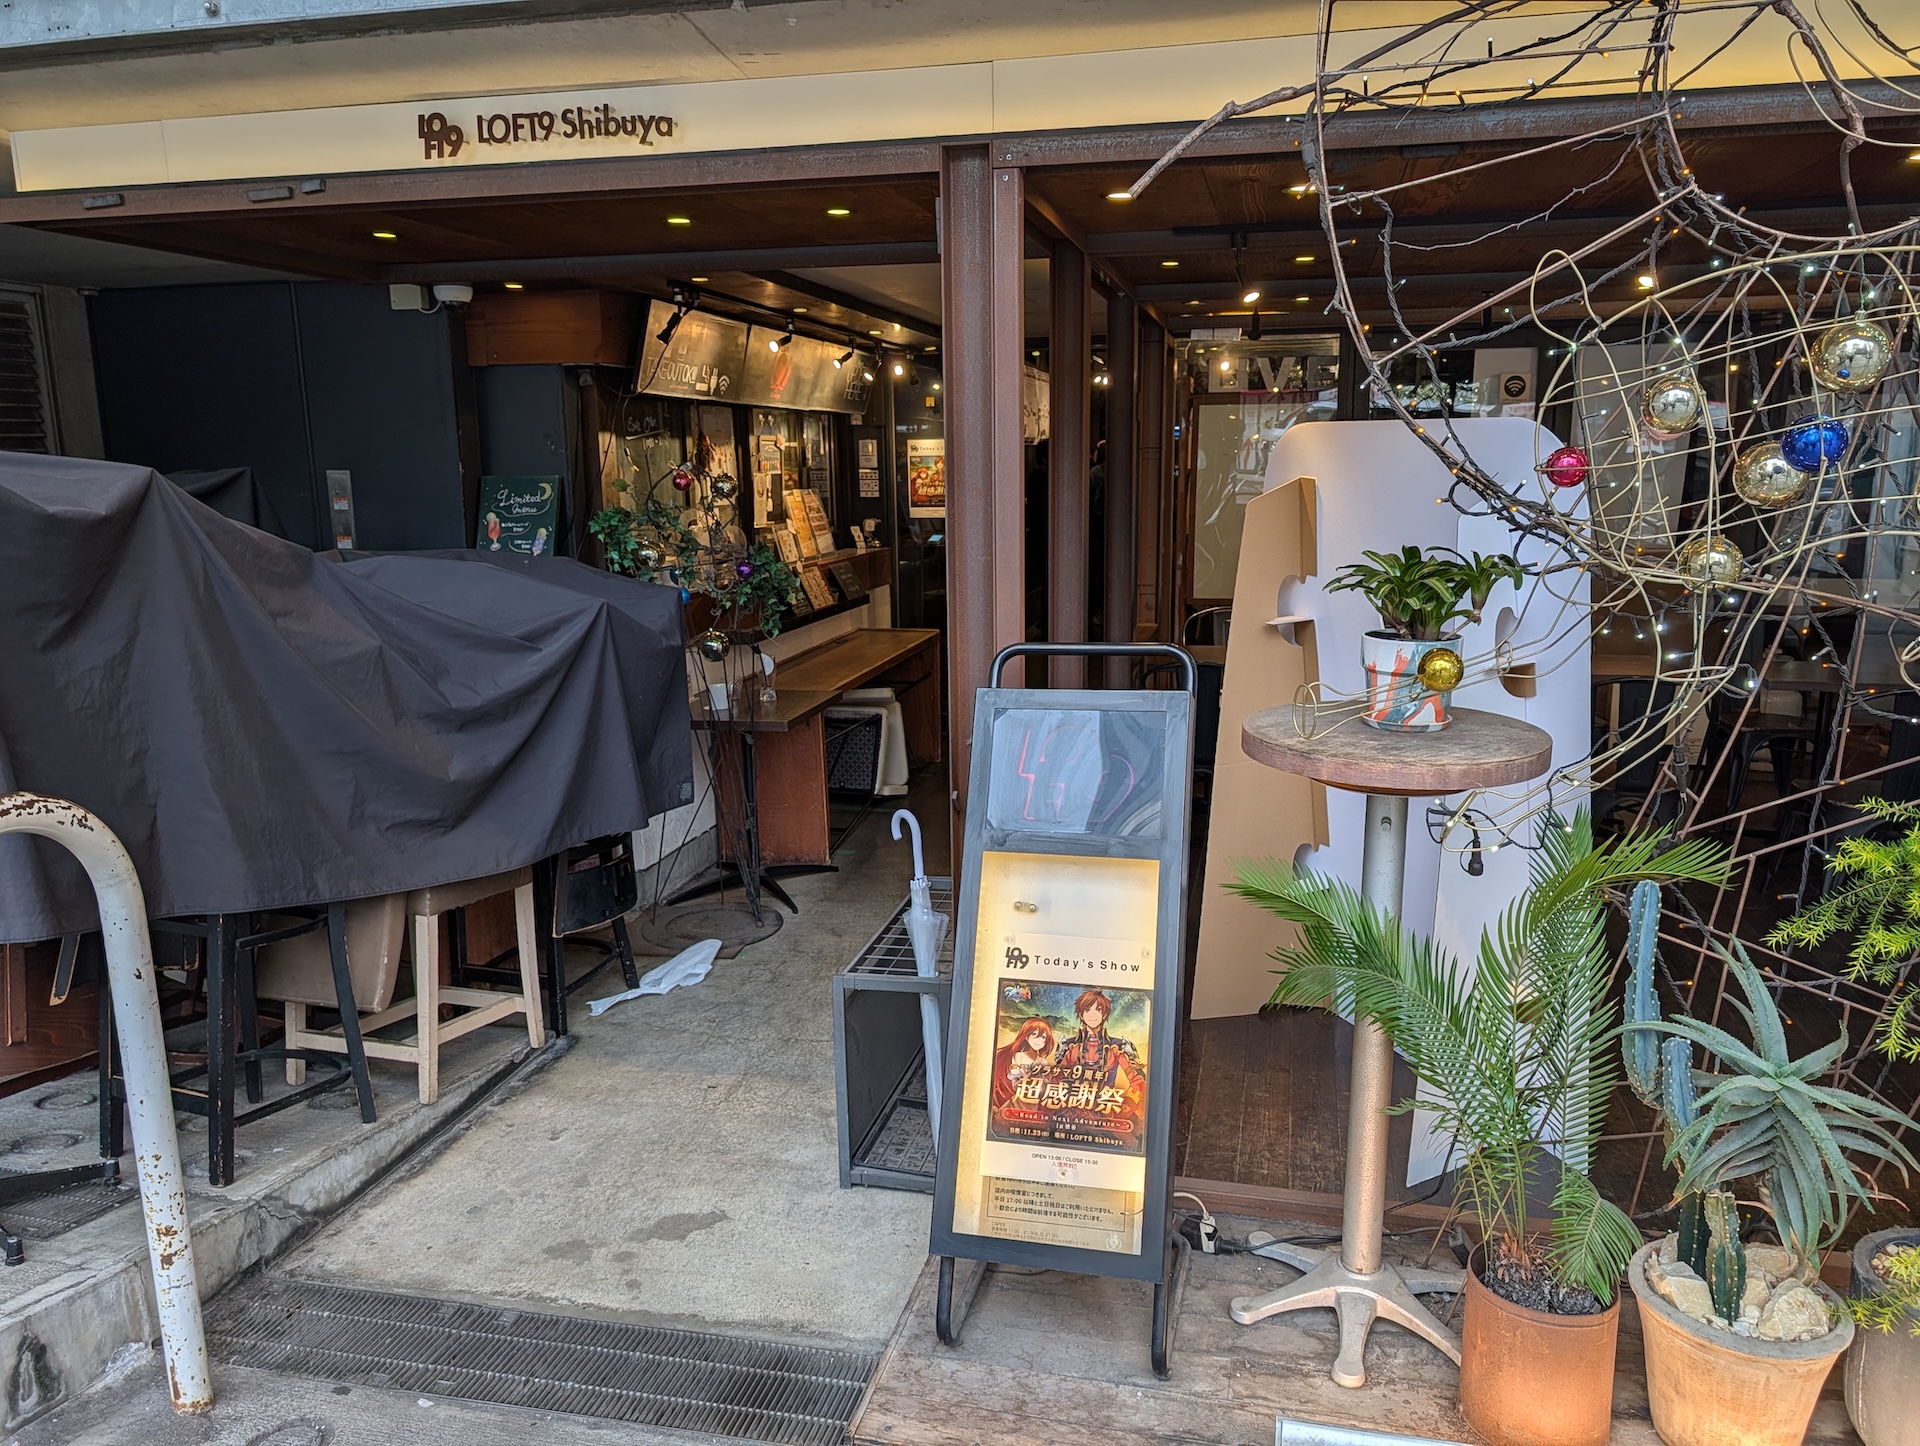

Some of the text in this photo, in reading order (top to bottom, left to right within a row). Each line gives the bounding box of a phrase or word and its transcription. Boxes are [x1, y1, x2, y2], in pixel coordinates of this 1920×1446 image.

[477, 104, 673, 147] LOFT9 Shibuya
[497, 489, 541, 507] Limited
[1034, 955, 1140, 972] Today's Show
[1012, 1075, 1125, 1115] 超感謝祭
[1041, 1113, 1049, 1121] to
[1052, 1115, 1070, 1123] Next
[1095, 1137, 1123, 1146] Shibuya
[1065, 1156, 1084, 1164] CLOSE
